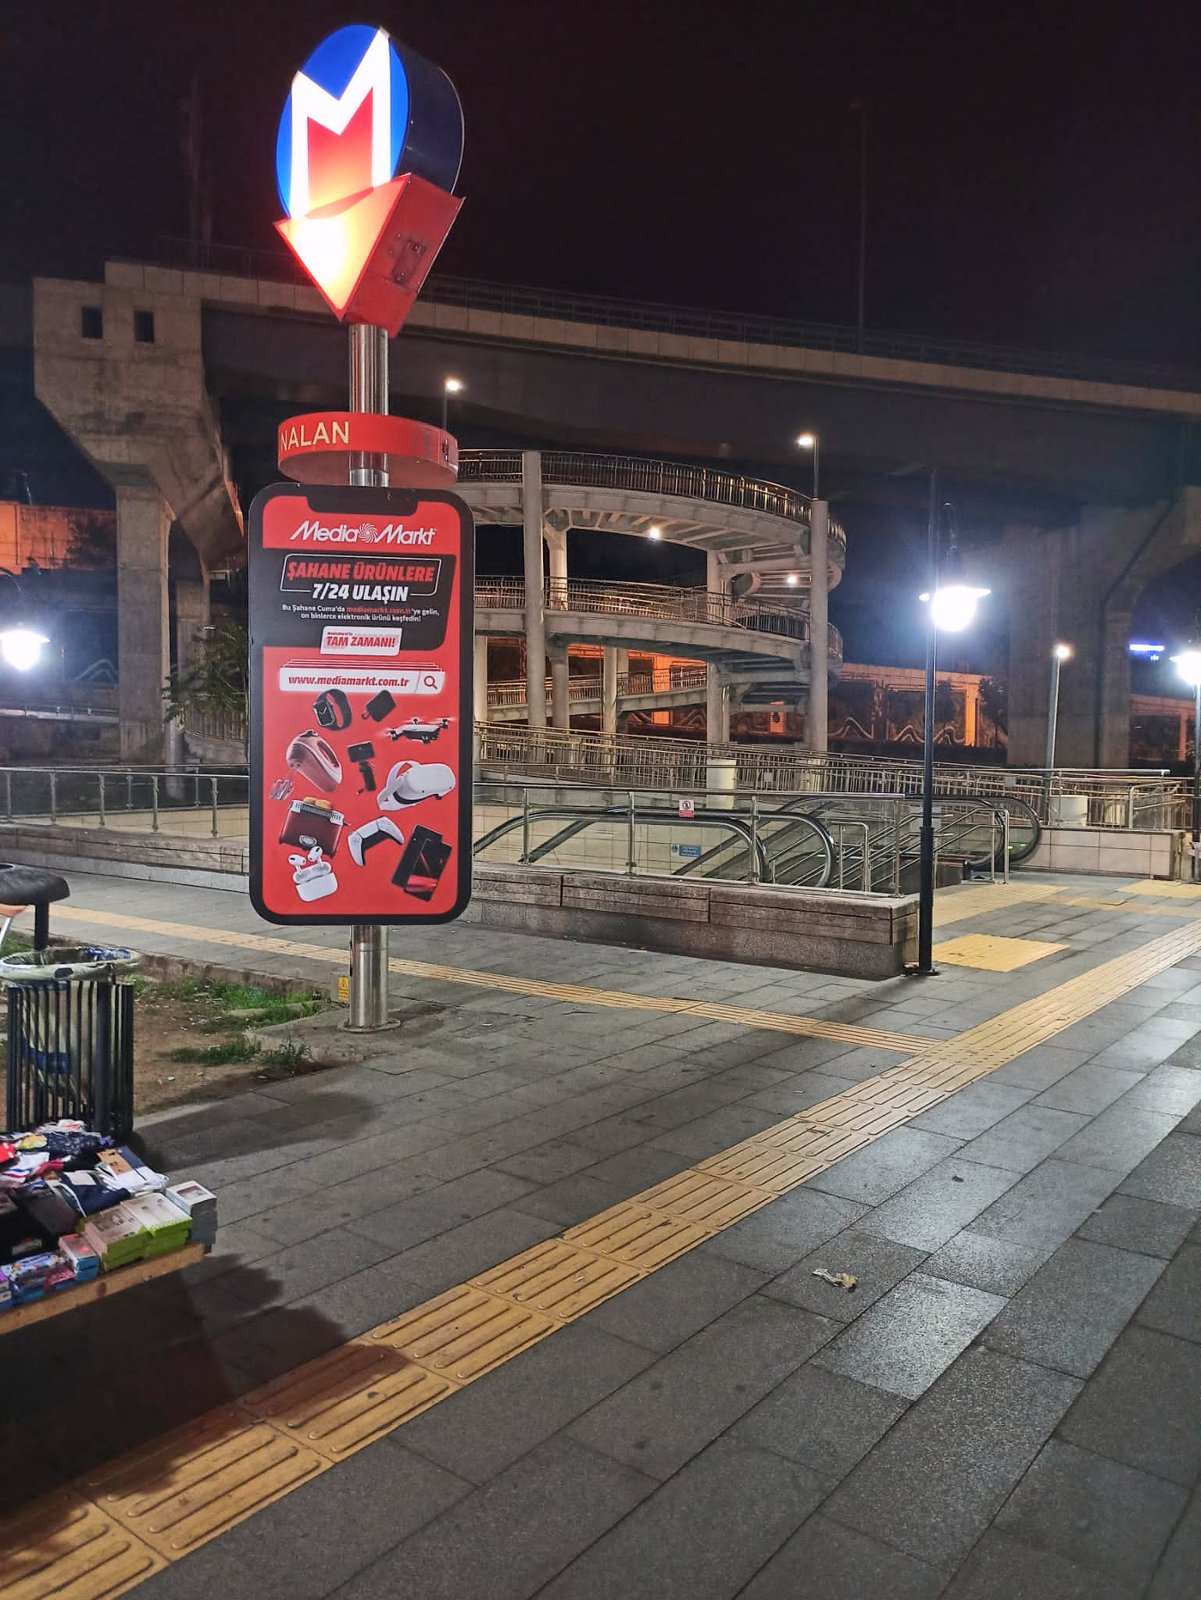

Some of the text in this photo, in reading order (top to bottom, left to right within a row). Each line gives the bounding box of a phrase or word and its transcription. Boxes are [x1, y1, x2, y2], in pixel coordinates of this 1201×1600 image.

[288, 27, 392, 219] M
[287, 561, 435, 582] ŞAHANE ÜRÜNLERE
[312, 582, 409, 604] 7/24 ULAŞIN
[281, 603, 292, 611] Bu
[292, 604, 316, 612] Şahane
[310, 612, 337, 620] binlerce
[337, 613, 371, 621] elektronik
[392, 614, 422, 623] keşfedin!
[326, 636, 396, 648] TAM ZAMANI!
[288, 675, 410, 687] www.mediamarkt.com.tr
